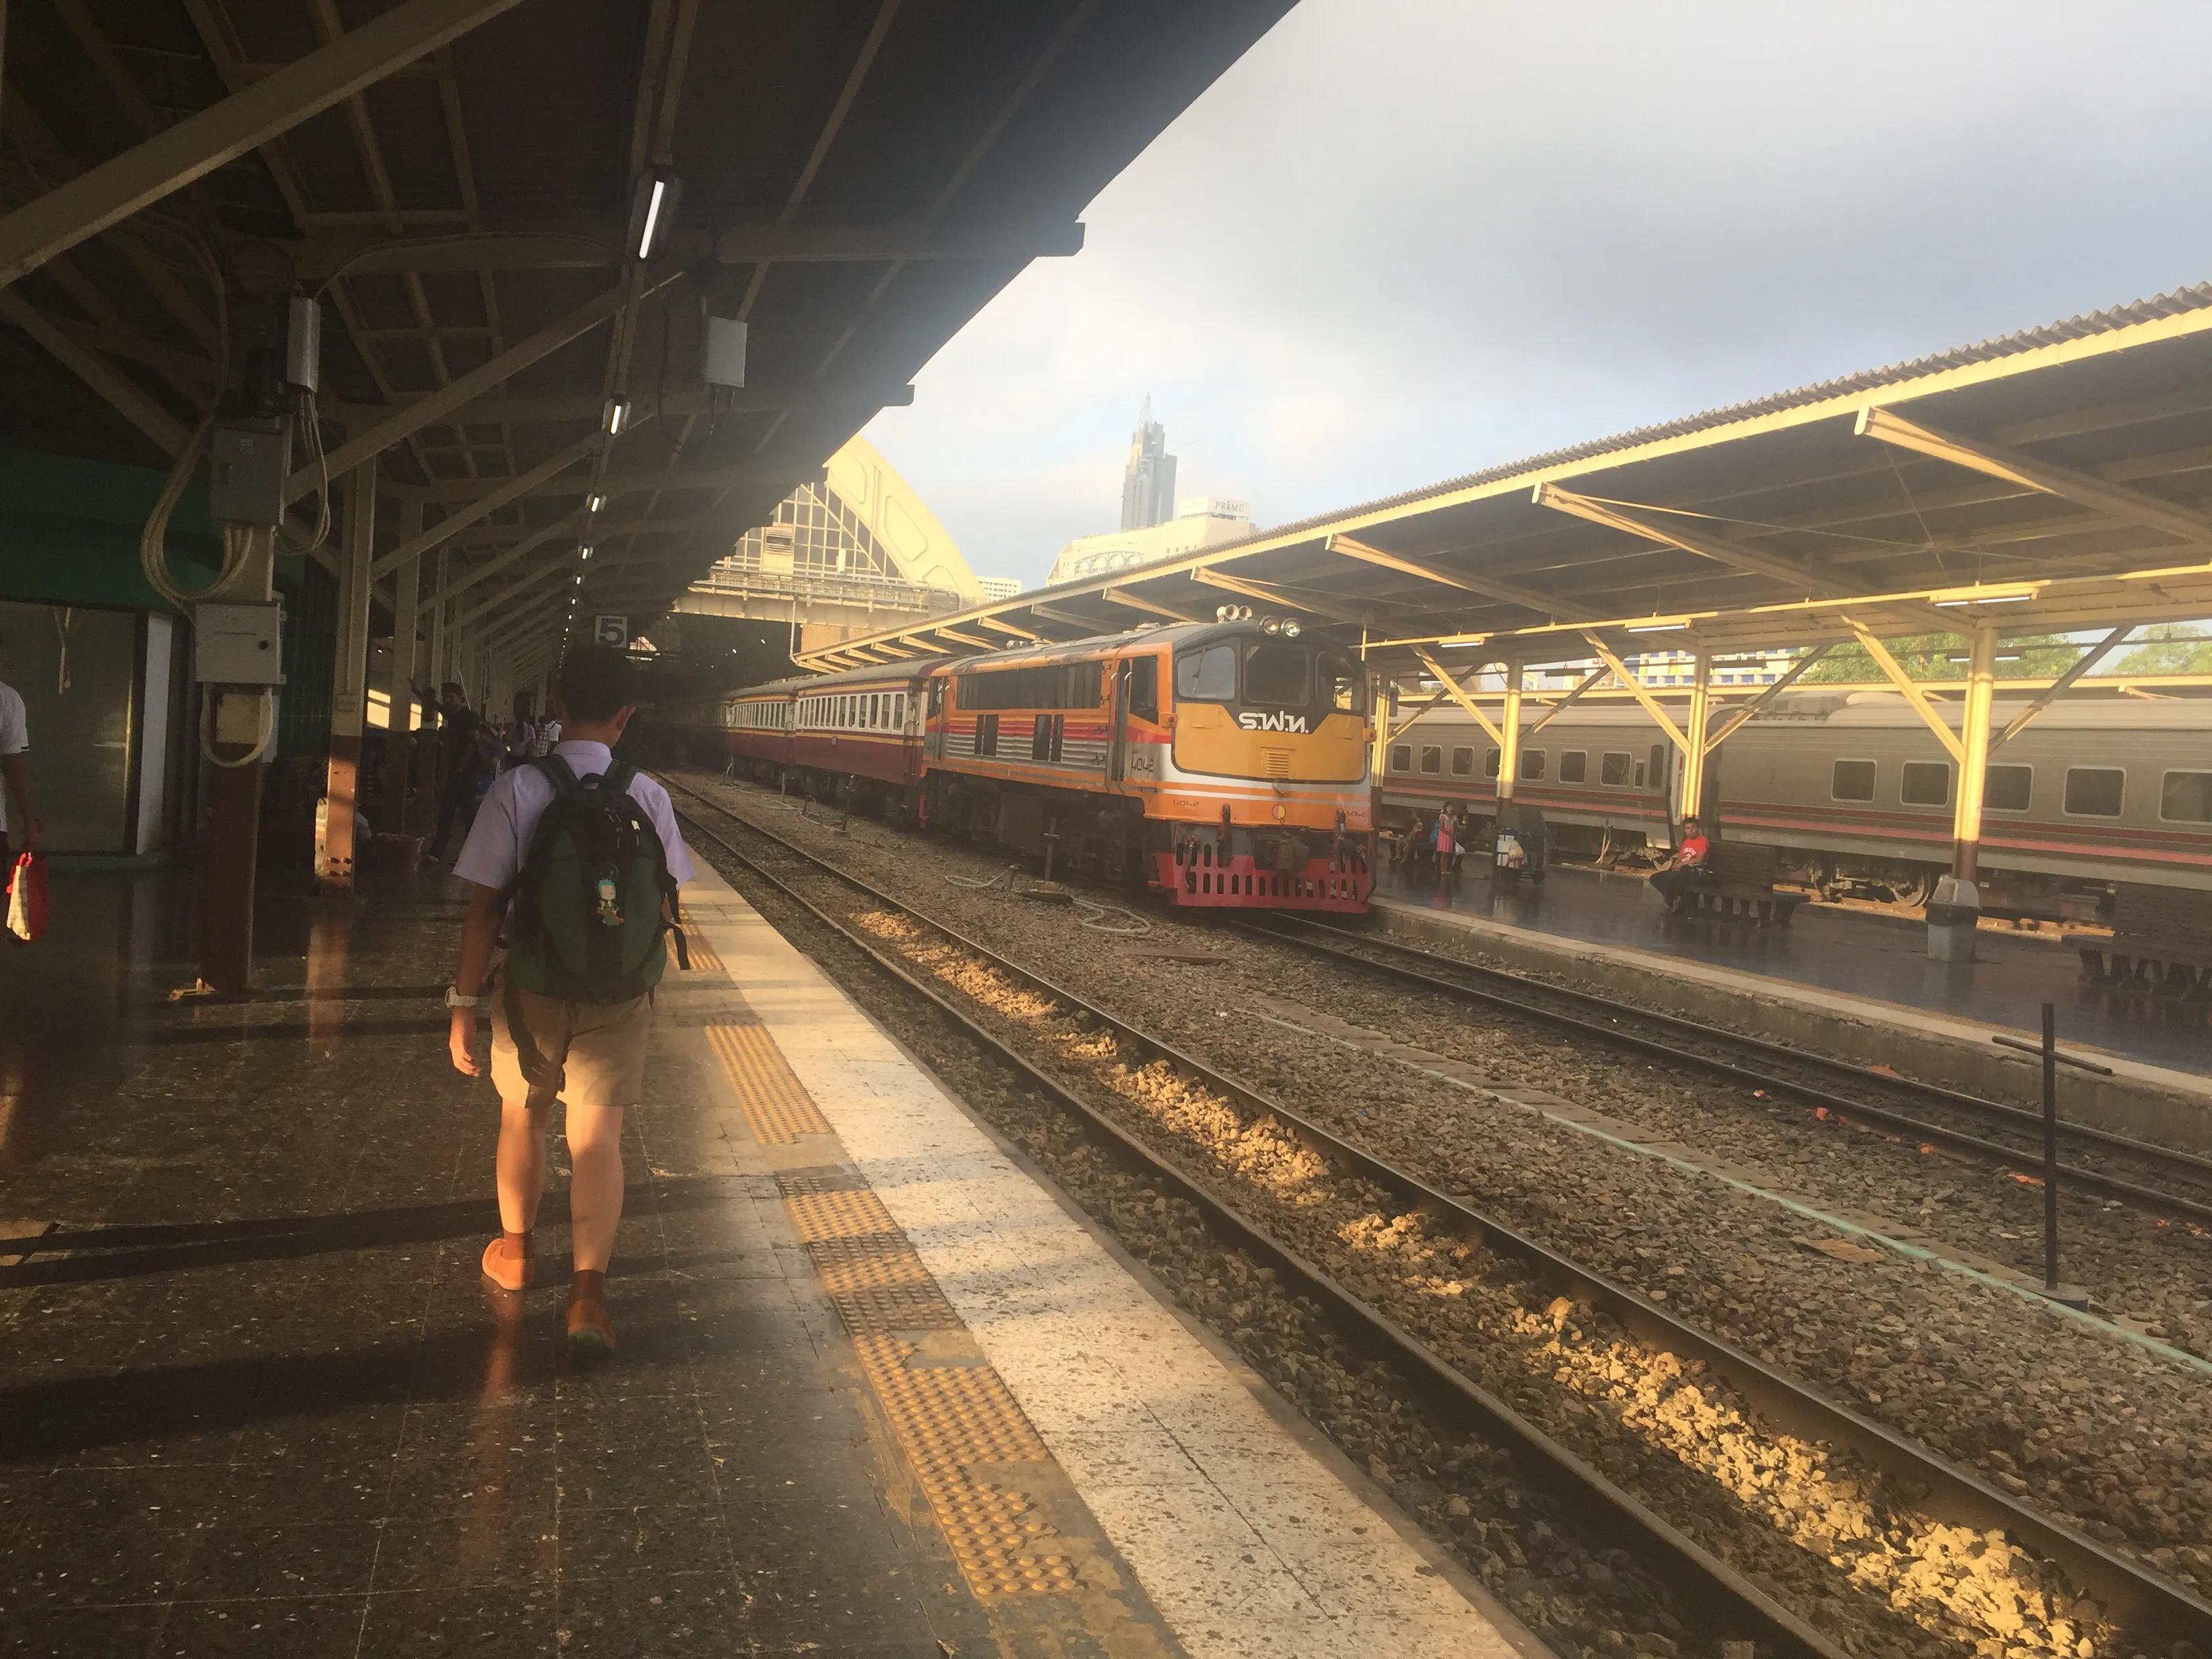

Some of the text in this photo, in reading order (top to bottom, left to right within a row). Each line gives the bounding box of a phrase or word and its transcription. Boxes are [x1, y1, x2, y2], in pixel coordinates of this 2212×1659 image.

[1215, 501, 1244, 512] PRIME
[598, 617, 624, 646] 5
[1131, 756, 1154, 772] 4042
